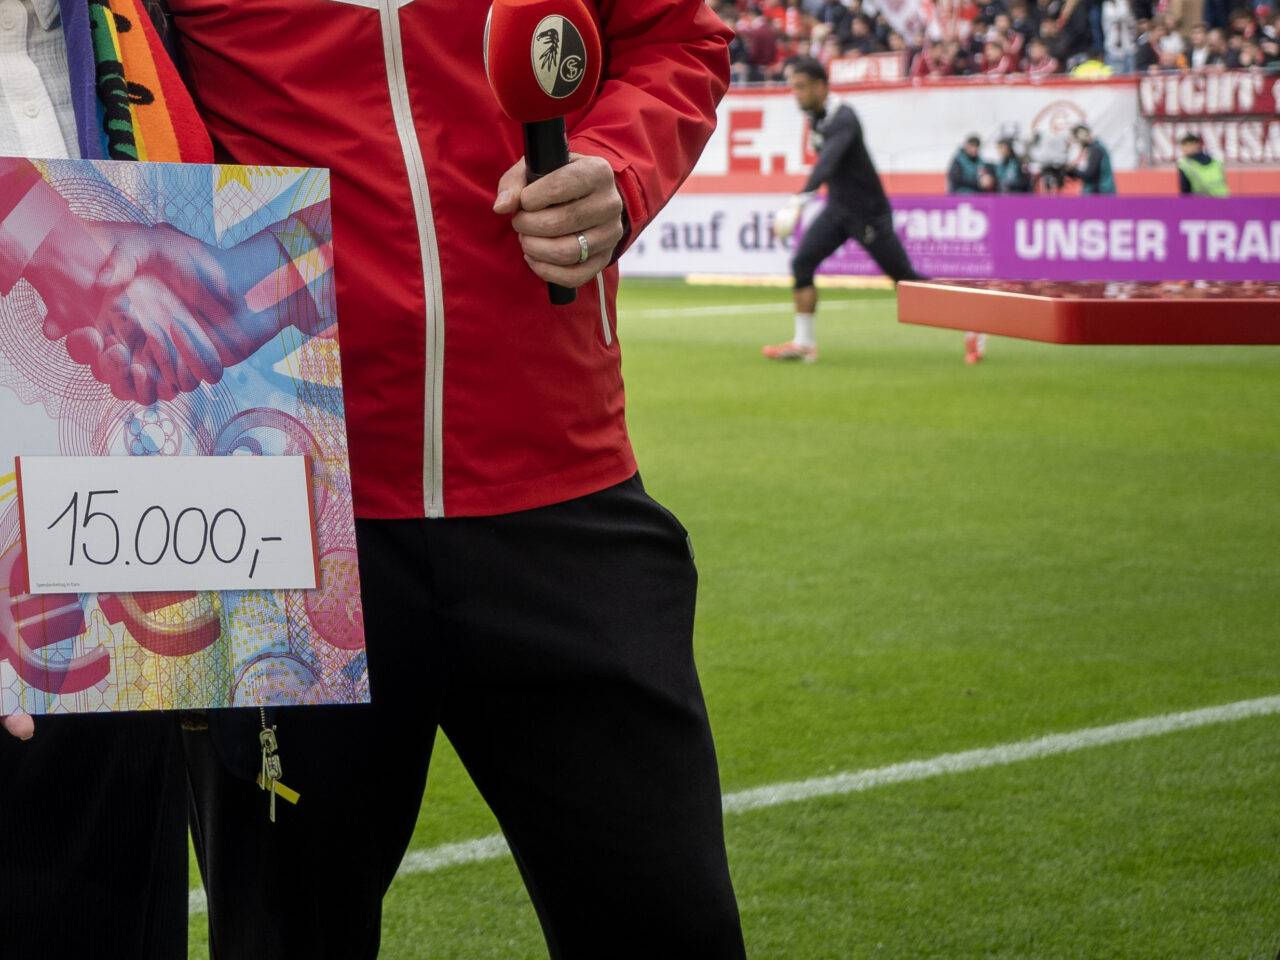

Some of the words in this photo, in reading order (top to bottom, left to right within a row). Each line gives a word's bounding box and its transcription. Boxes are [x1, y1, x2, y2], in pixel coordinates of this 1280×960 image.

[660, 210, 721, 253] auf
[738, 211, 790, 253] di
[1015, 218, 1168, 261] UNSER
[47, 489, 282, 579] 15.000,-
